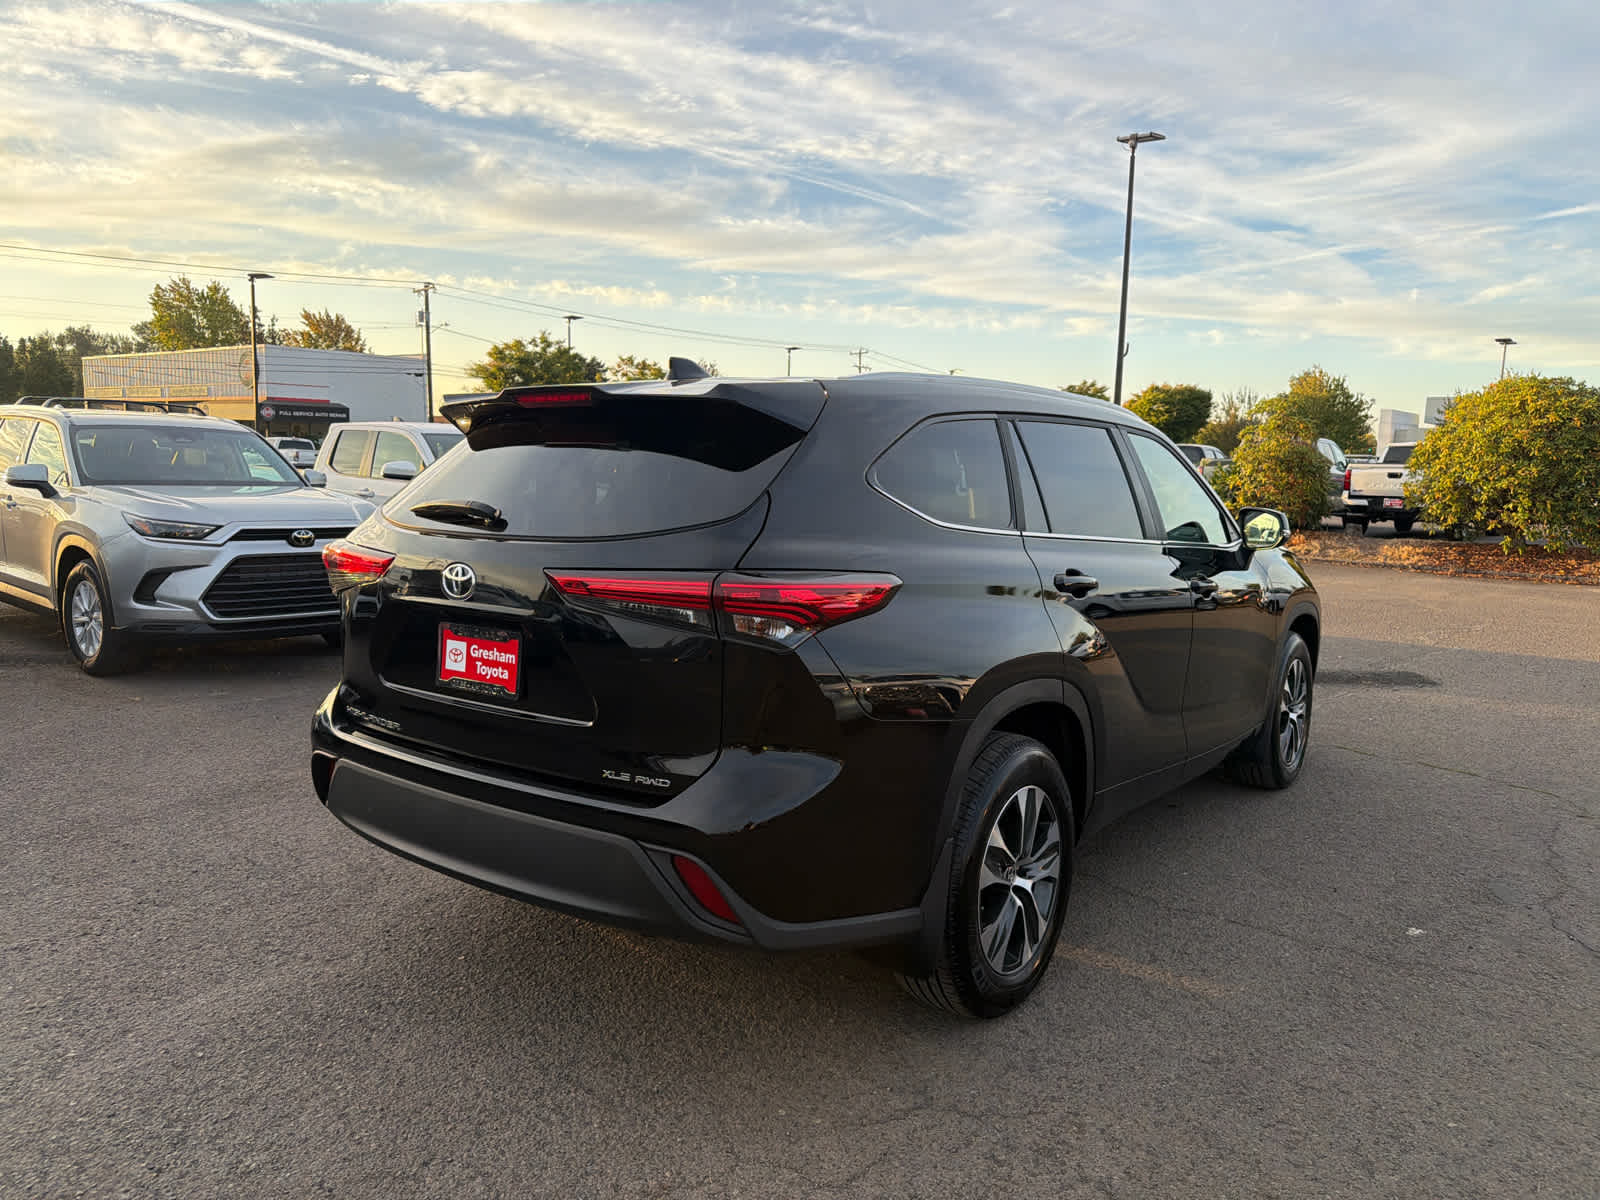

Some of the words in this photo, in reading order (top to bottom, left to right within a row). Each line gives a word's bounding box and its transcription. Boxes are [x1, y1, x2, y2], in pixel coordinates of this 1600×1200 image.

[470, 644, 516, 664] Gresham
[475, 661, 509, 680] Toyota
[602, 769, 631, 782] XLE
